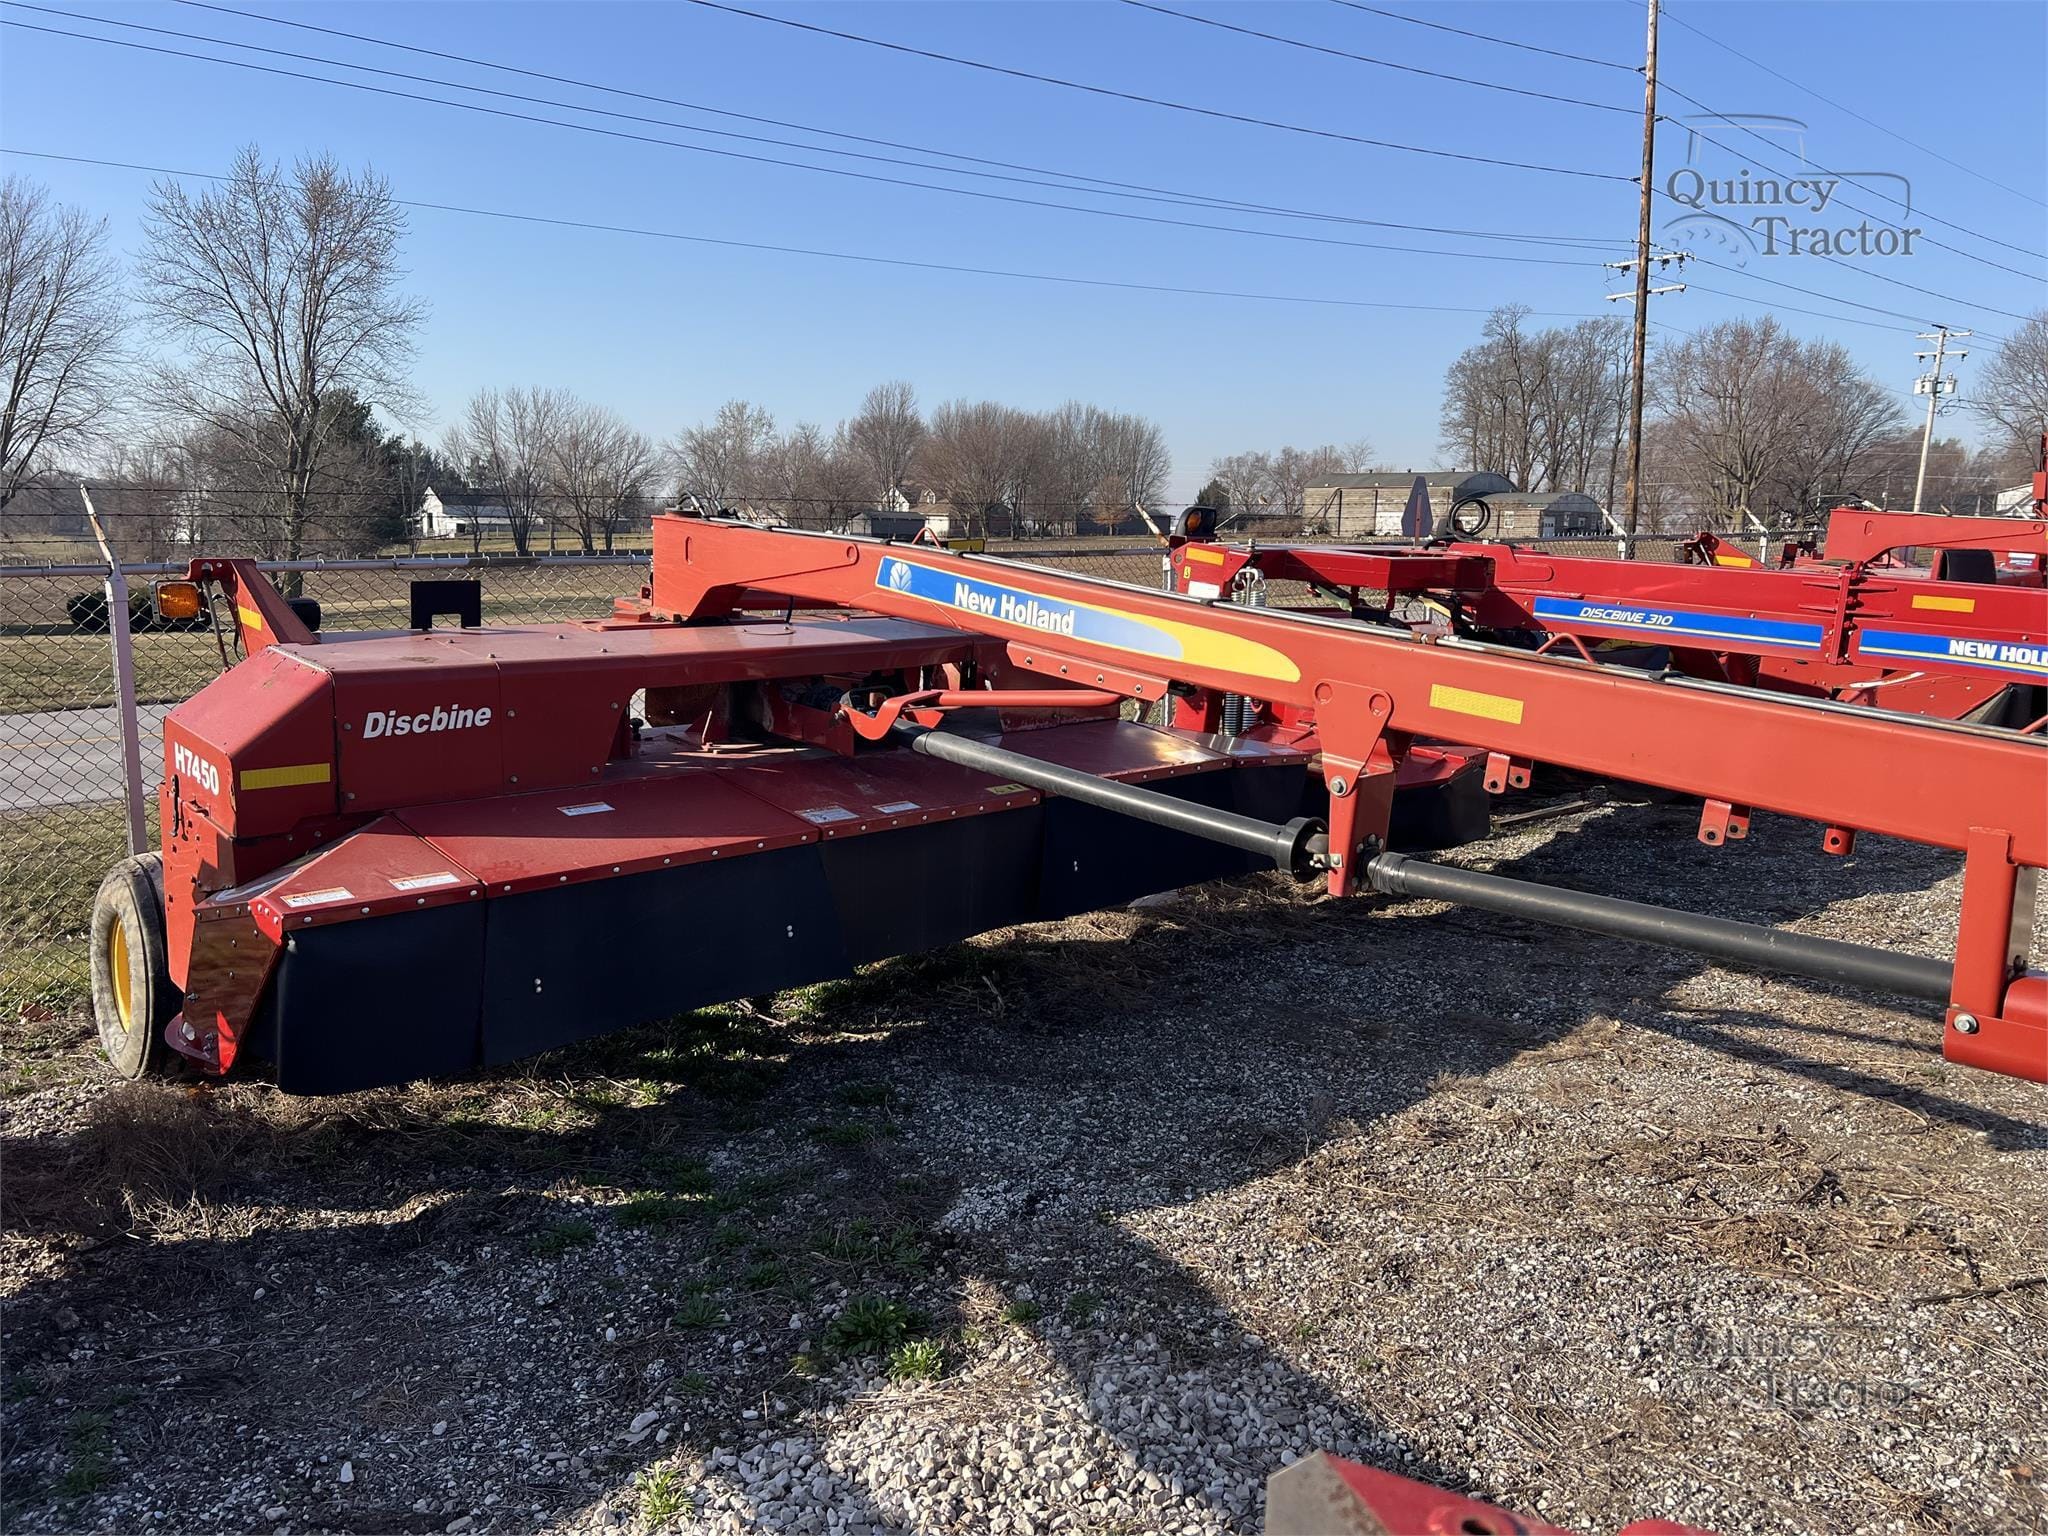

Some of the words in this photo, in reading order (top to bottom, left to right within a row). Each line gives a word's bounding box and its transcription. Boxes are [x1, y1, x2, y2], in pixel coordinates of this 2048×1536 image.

[954, 582, 996, 614] New
[1001, 593, 1075, 634] Holland
[1579, 607, 1645, 622] DISCBINE
[1646, 613, 1674, 625] 310
[1949, 639, 1997, 660] NEW
[363, 704, 492, 739] Discbine
[174, 741, 219, 796] H7450
